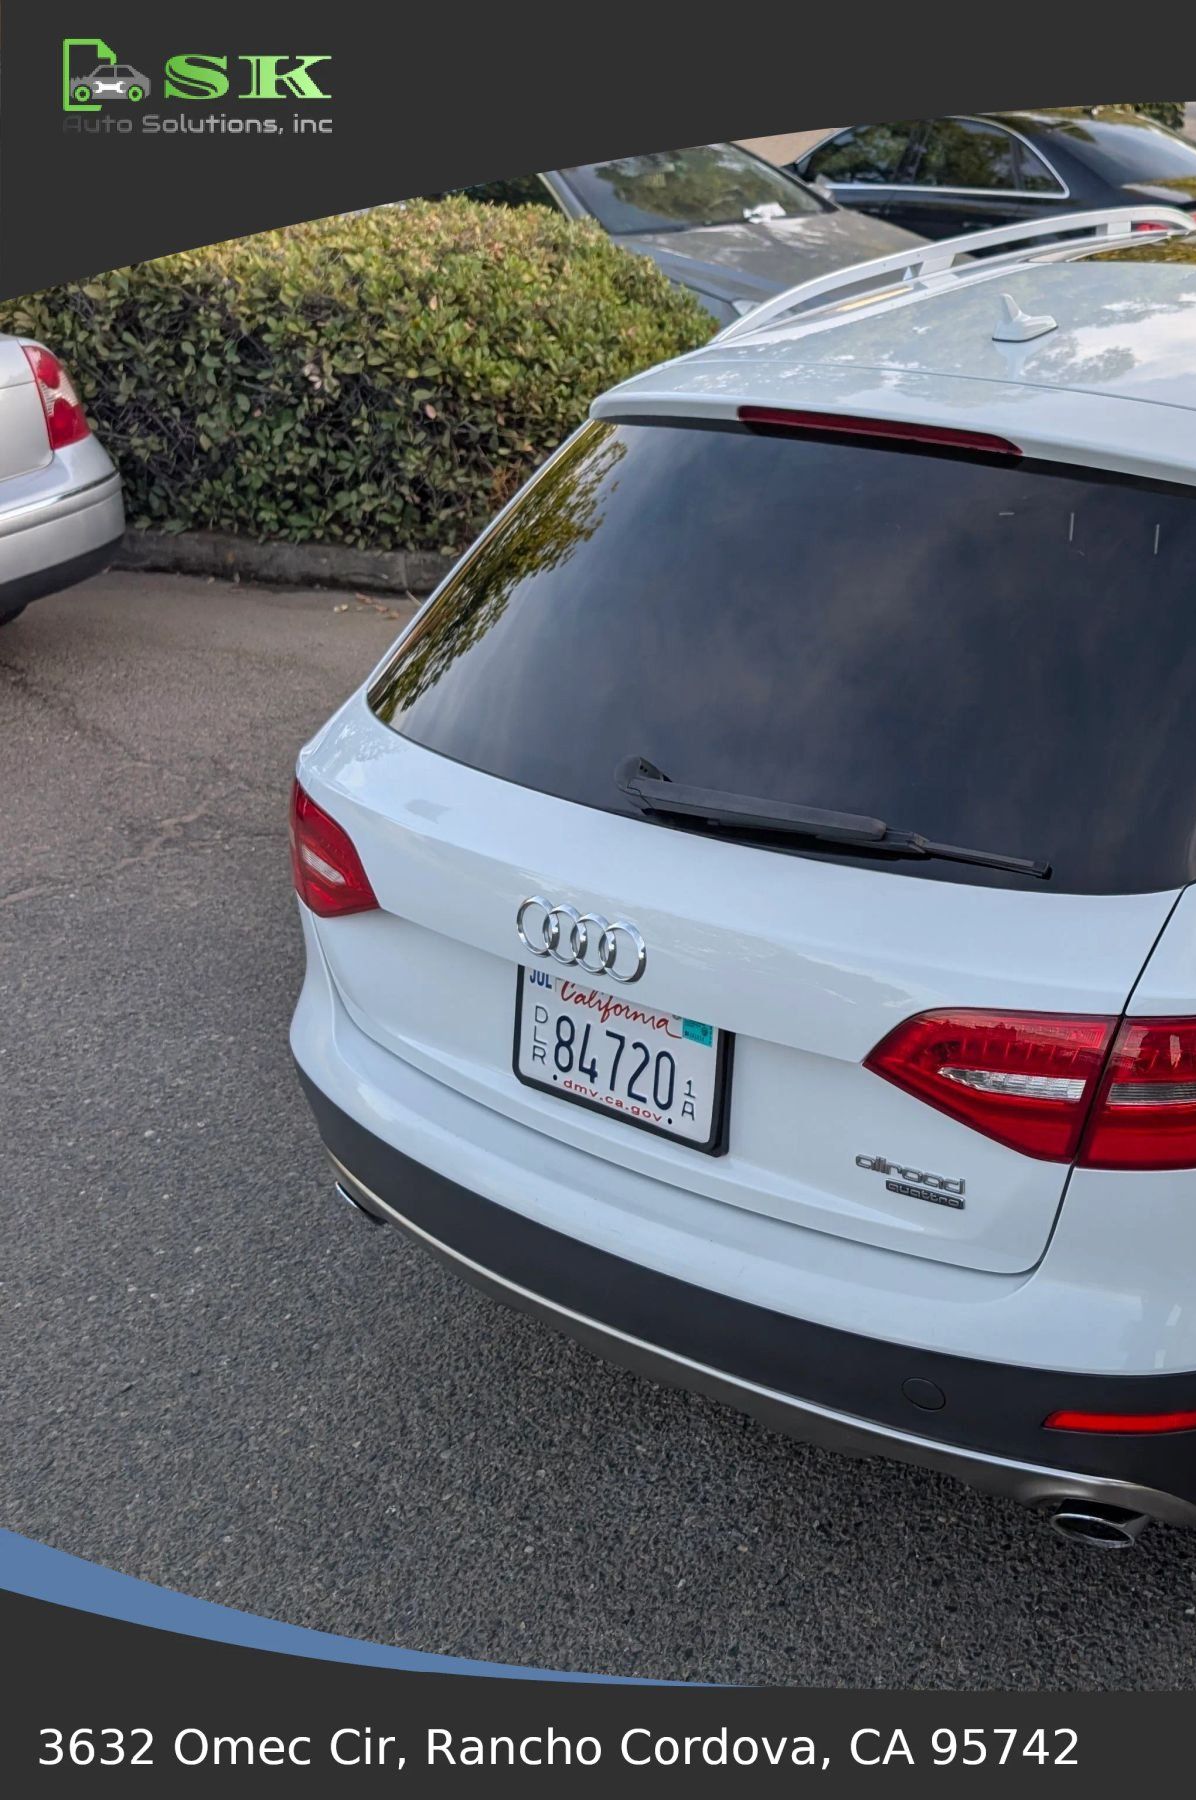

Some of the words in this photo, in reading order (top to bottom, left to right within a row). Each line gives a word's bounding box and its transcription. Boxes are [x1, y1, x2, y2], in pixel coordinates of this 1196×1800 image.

[529, 969, 552, 990] JUL
[560, 980, 682, 1040] California
[553, 1014, 676, 1111] 84720
[562, 1078, 663, 1123] dmv.ca.gov
[855, 1154, 966, 1195] allroad
[887, 1182, 961, 1208] quattro
